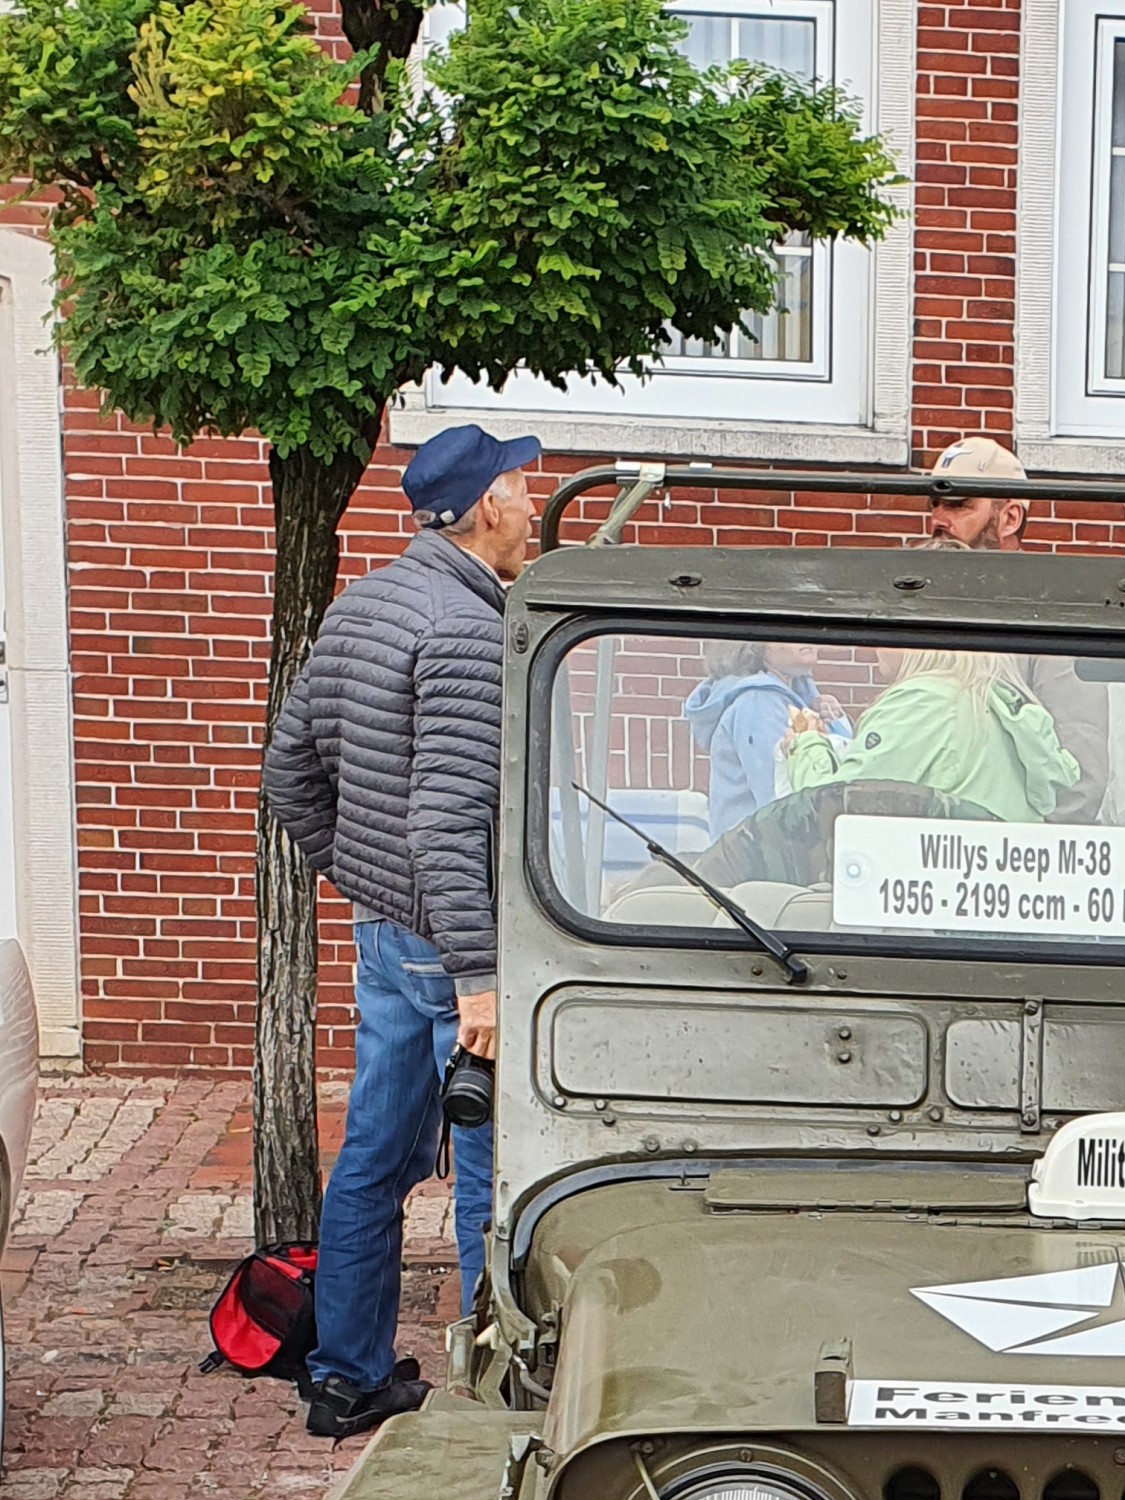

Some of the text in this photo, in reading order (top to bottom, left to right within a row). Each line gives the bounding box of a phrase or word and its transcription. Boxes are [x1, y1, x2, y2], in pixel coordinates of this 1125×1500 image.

[920, 833, 1111, 882] Willys Jeep M-38
[879, 878, 933, 915] 1956
[955, 882, 1010, 919] 2199
[1018, 893, 1065, 921] ccm
[1087, 887, 1114, 923] 60
